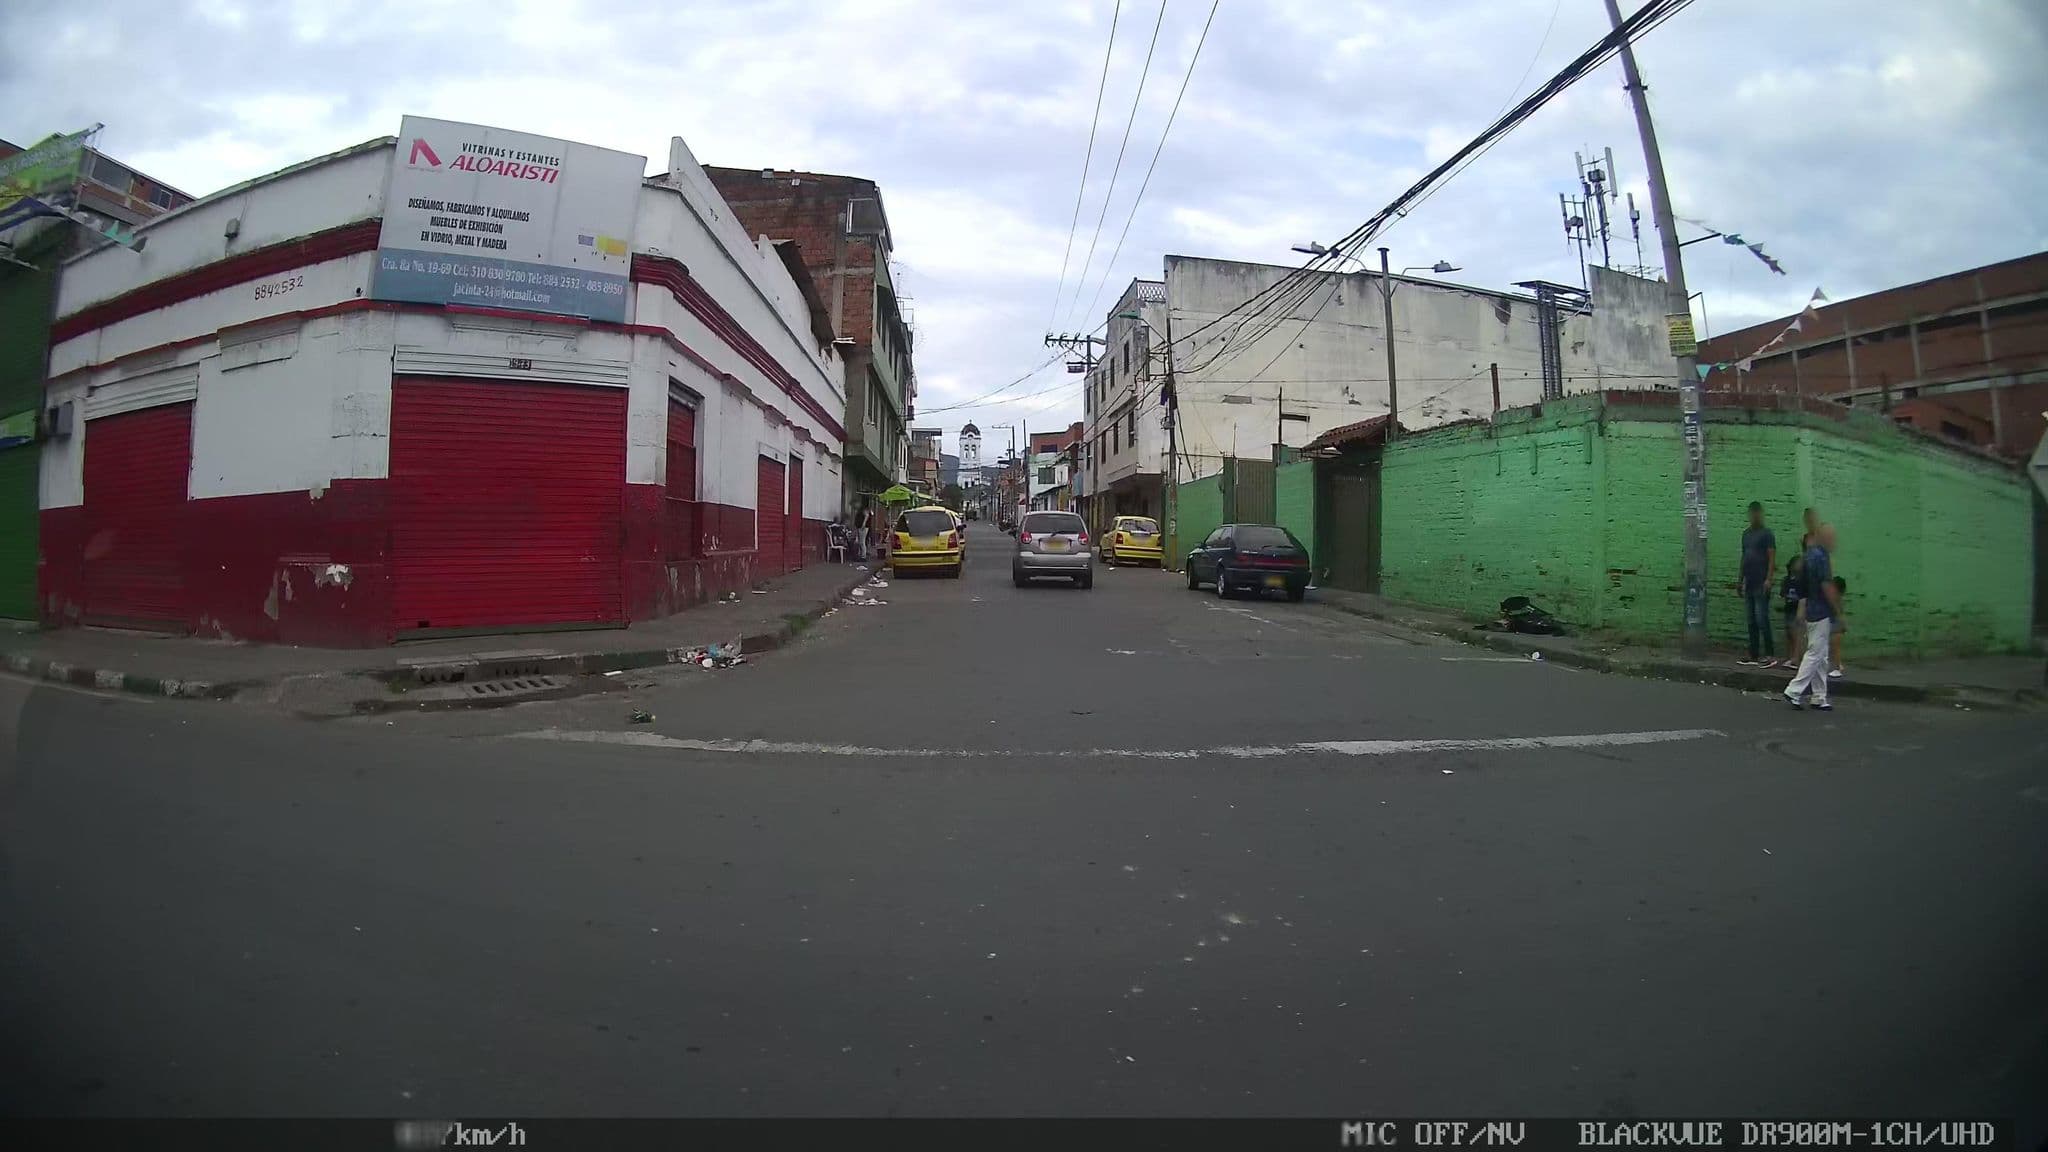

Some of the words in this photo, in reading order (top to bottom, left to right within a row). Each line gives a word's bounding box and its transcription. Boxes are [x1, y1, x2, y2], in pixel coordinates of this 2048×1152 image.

[462, 142, 506, 158] VITRINAS
[508, 150, 514, 160] Y
[516, 151, 560, 167] ESTANTES
[449, 154, 559, 184] ALOARISTI
[430, 216, 458, 229] MUEBLES
[459, 219, 467, 230] DE
[446, 202, 485, 217] FABRICAMOS
[486, 206, 492, 217] Y
[491, 207, 530, 223] ALQUILAMOS
[421, 230, 430, 242] EN
[455, 234, 475, 246] METAL
[476, 236, 482, 247] Y
[482, 237, 508, 251] MADERA
[471, 265, 487, 278] 310
[254, 274, 304, 301] 8842532
